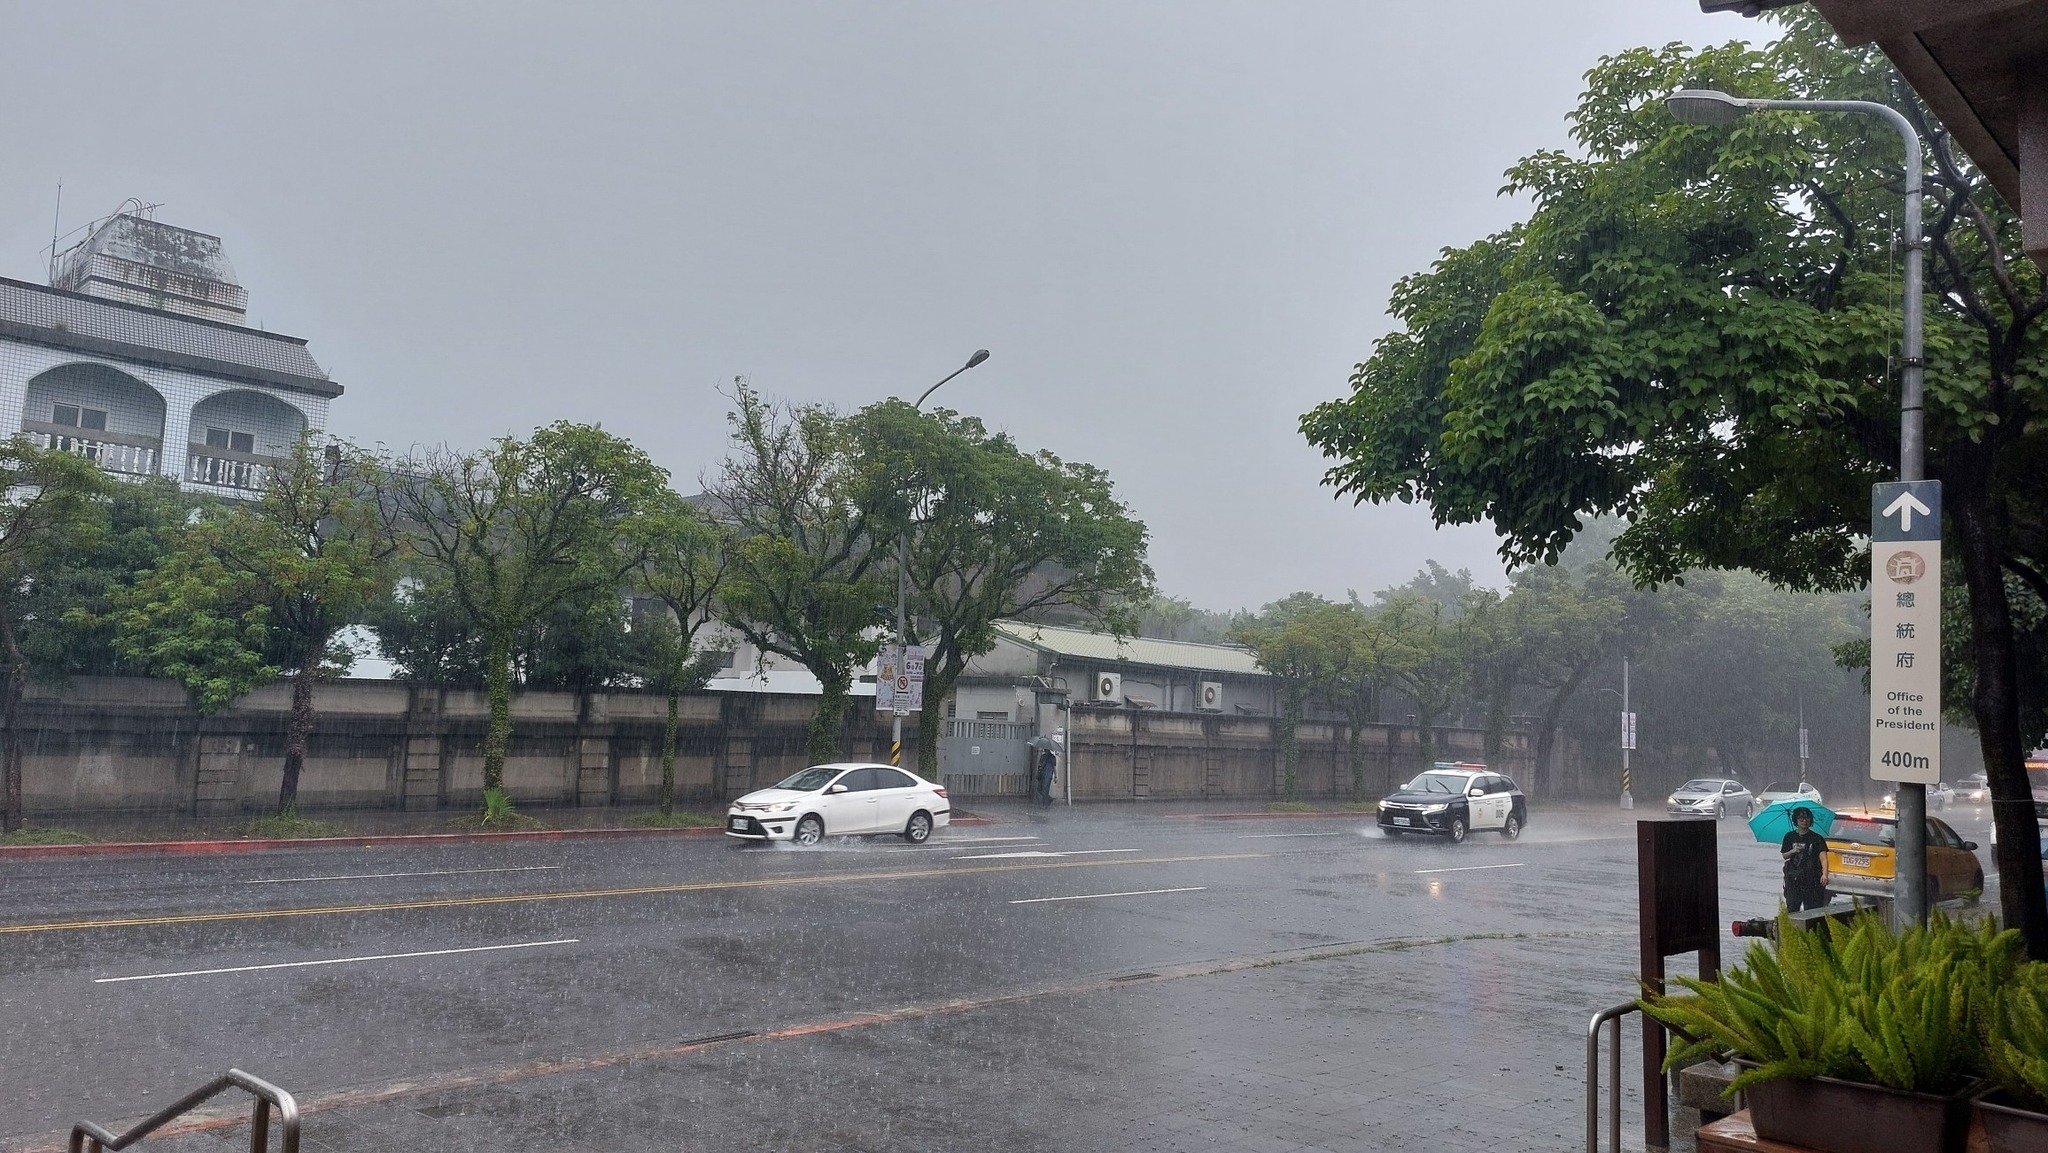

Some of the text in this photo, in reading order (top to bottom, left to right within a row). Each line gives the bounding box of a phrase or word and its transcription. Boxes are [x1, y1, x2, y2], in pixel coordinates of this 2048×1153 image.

[1896, 591, 1915, 669] 總統府
[1887, 691, 1924, 702] Office
[1887, 705, 1923, 716] of the
[1876, 718, 1935, 731] President
[1881, 750, 1929, 769] 400m
